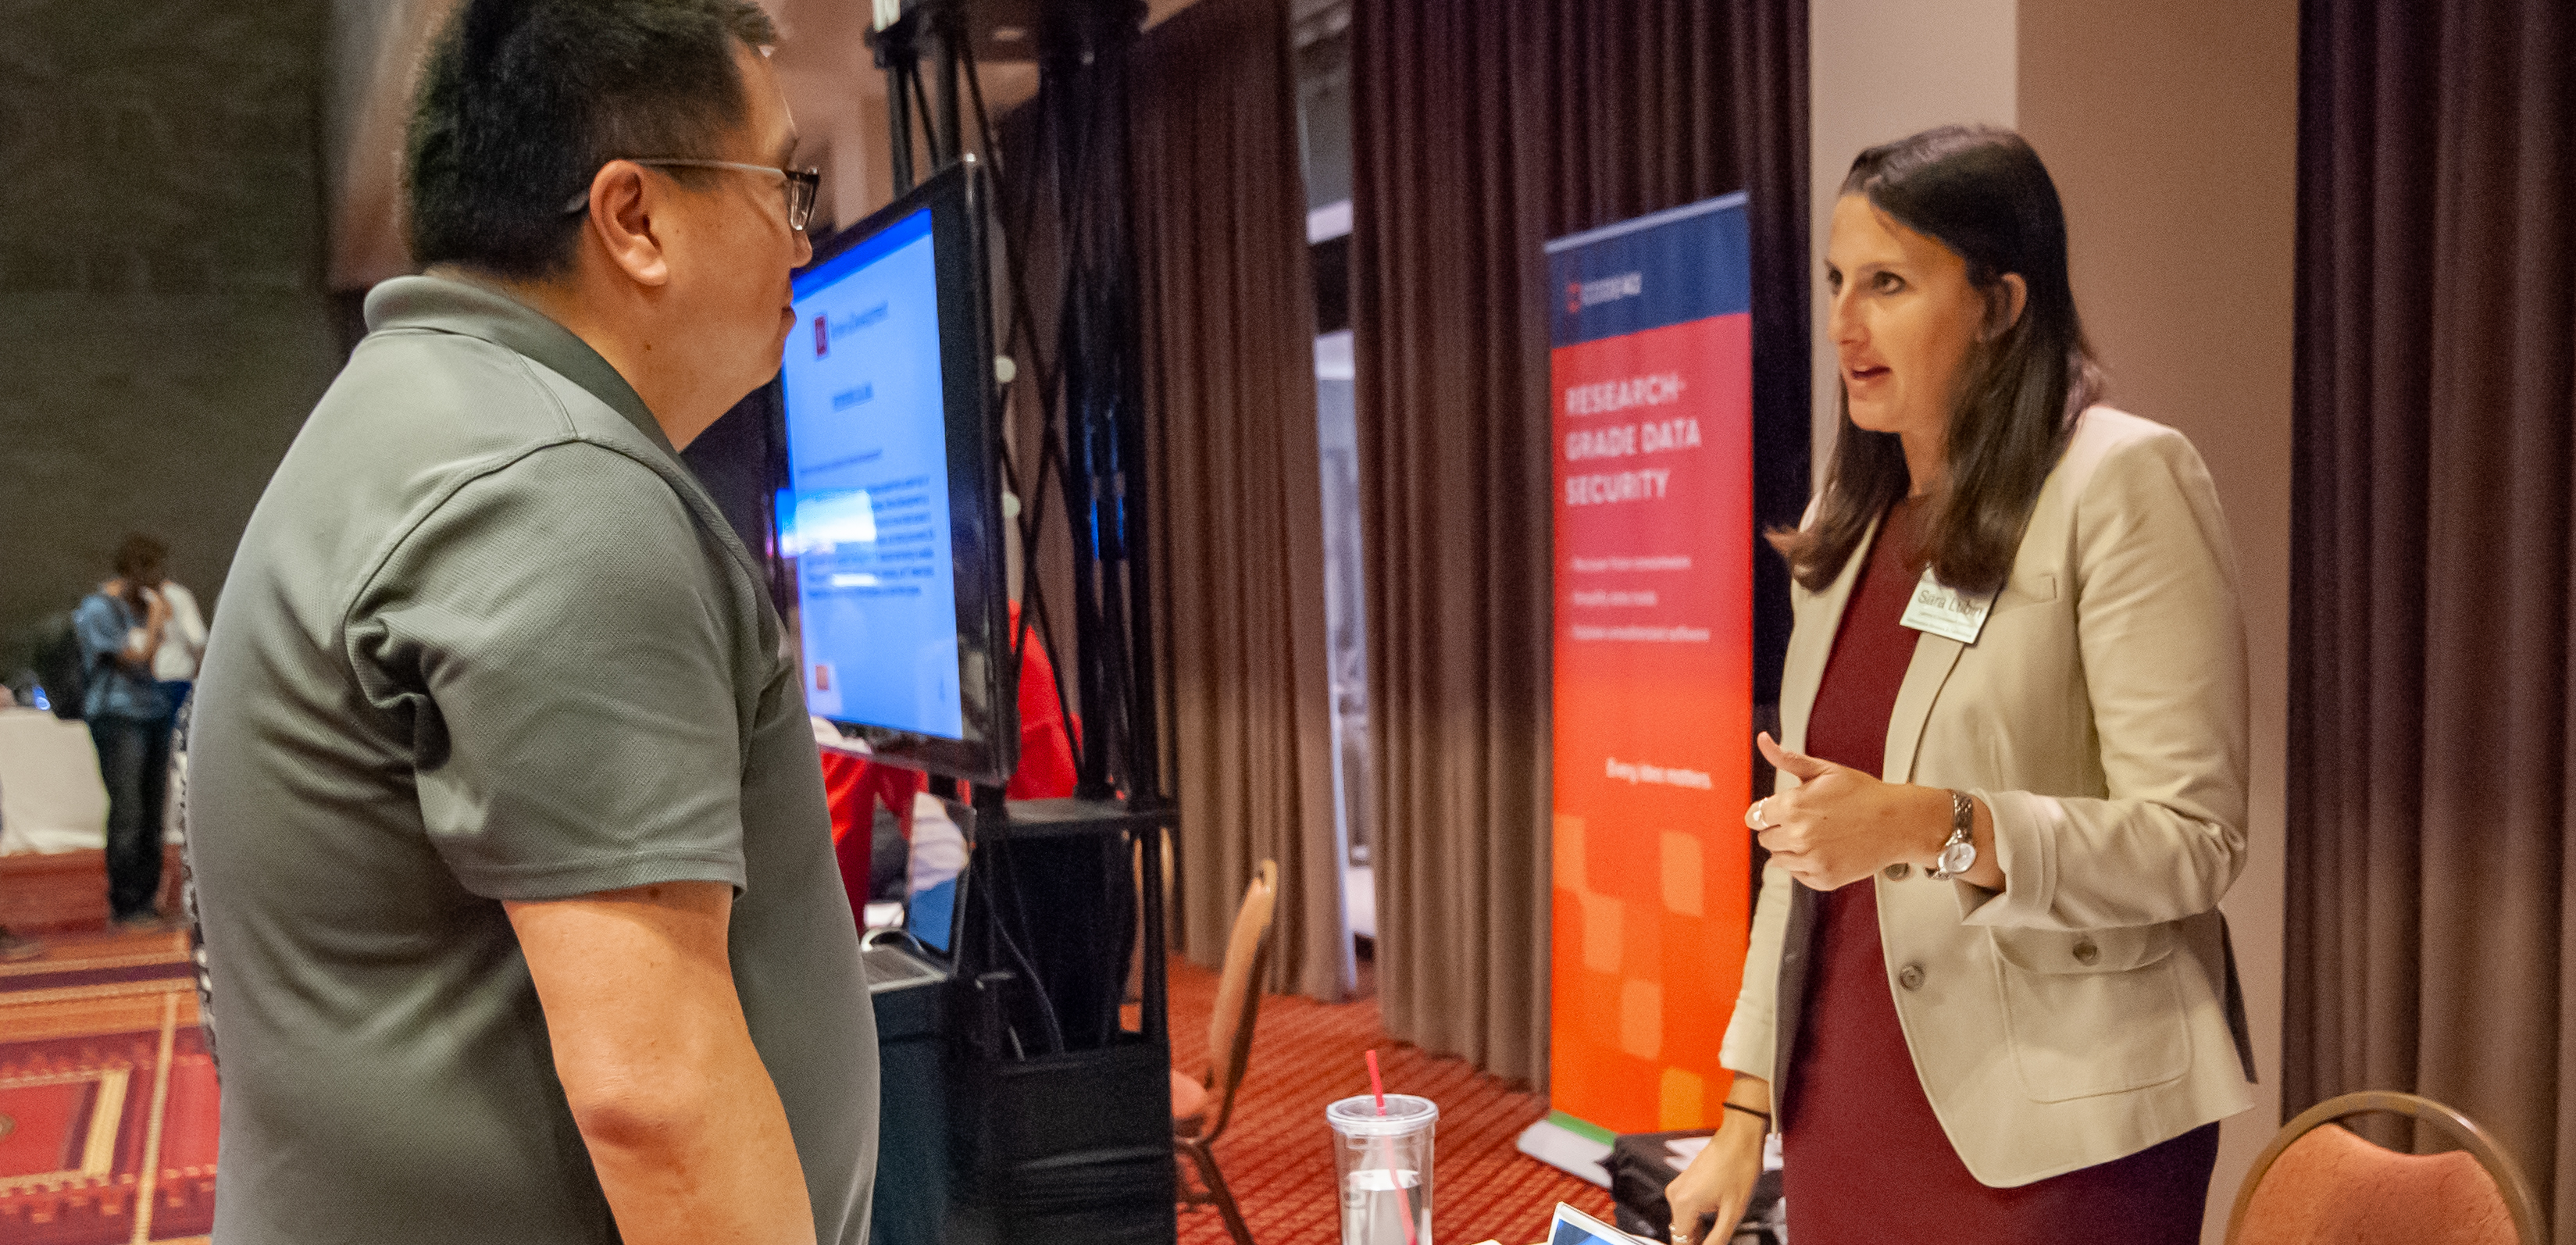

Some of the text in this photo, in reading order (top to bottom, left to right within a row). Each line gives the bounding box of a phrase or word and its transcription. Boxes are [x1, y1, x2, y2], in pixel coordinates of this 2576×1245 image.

[1565, 373, 1685, 415] RESEARCH-
[1565, 418, 1700, 461] GRADE DATA
[1565, 469, 1670, 505] SECURITY
[1918, 590, 1946, 608] Sara
